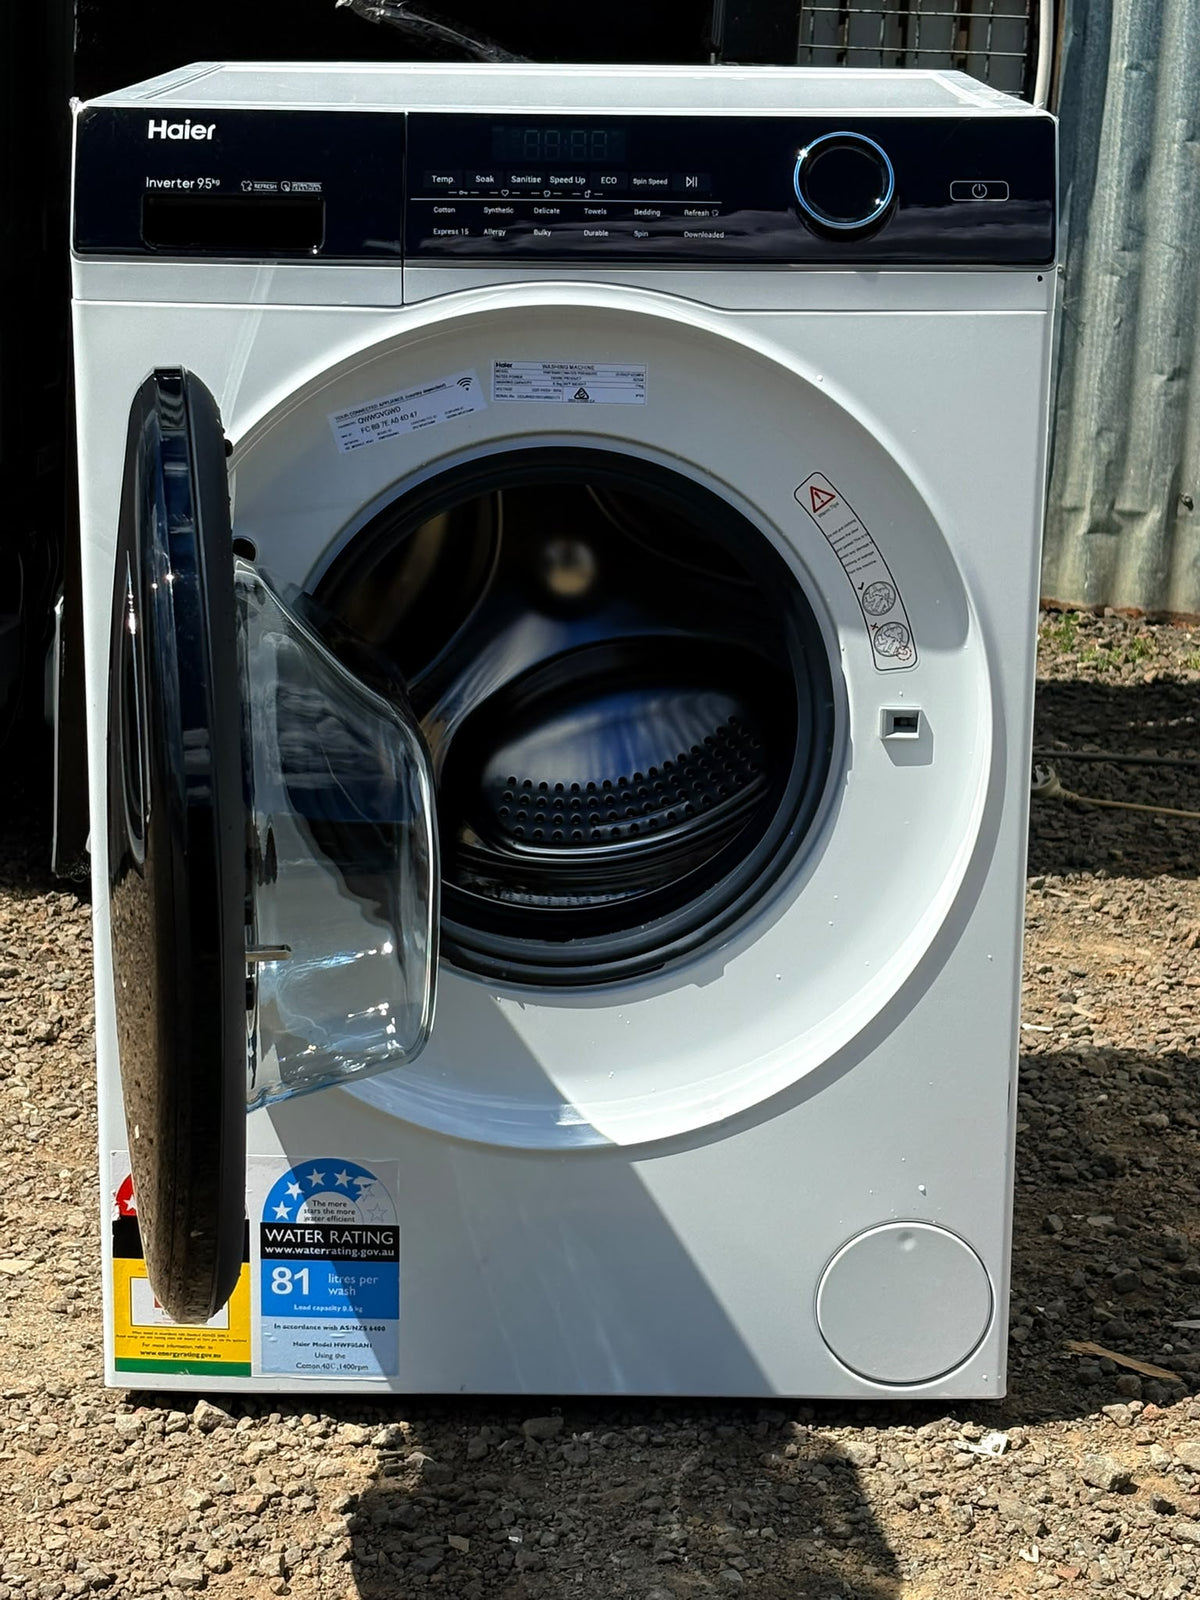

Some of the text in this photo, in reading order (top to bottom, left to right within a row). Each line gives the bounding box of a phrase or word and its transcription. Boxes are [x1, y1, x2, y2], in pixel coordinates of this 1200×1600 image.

[148, 120, 216, 140] Haier
[146, 176, 195, 189] Inverter
[476, 175, 494, 184] Soak
[511, 176, 542, 184] Sanitise
[550, 176, 586, 186] Speed Up
[601, 176, 617, 184] ECO
[633, 178, 668, 186] Spin Speed
[484, 206, 514, 215] Synthetic
[634, 209, 661, 217] Bedding
[433, 228, 461, 236] Express
[484, 228, 506, 237] Allergy
[534, 229, 552, 238] Bulky
[634, 230, 648, 238] Spin
[684, 230, 725, 239] Downloaded
[265, 1228, 394, 1245] WATER RATING
[265, 1246, 394, 1258] www.waterrating.gov.au
[271, 1267, 309, 1296] 81
[328, 1273, 378, 1286] litres per
[328, 1286, 356, 1296] wash
[312, 1304, 341, 1312] capacity
